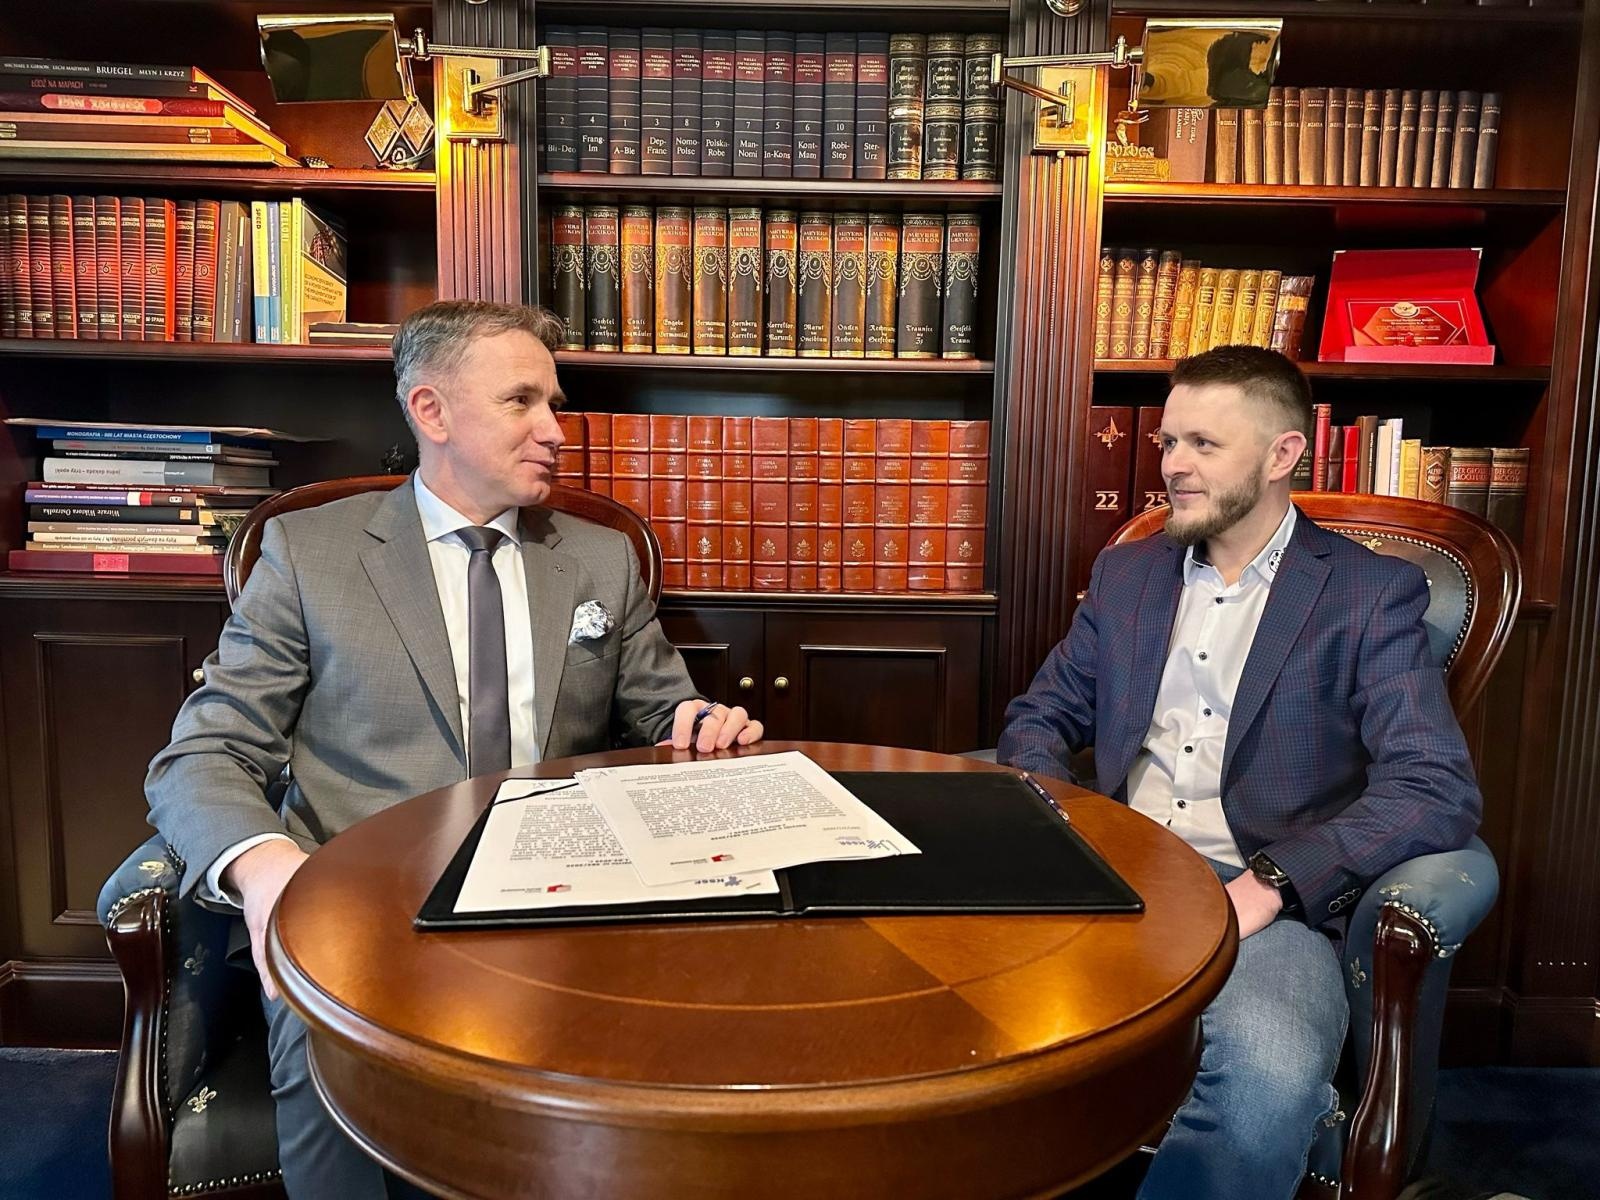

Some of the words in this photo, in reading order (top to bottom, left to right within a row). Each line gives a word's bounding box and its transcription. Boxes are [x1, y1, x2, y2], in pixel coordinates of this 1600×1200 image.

[96, 66, 133, 76] BRUEGEL
[58, 81, 84, 89] MAPACH
[560, 116, 565, 124] 2
[590, 116, 595, 124] 4
[654, 119, 660, 127] 3
[715, 120, 720, 129] 9
[746, 121, 751, 129] 7
[775, 121, 780, 130] 5
[805, 123, 810, 132] 6
[836, 123, 844, 131] 10
[588, 144, 598, 152] Im
[647, 146, 667, 155] Franc
[708, 148, 725, 157] Robe
[1106, 141, 1155, 158] Forbes
[738, 149, 758, 158] Nomi
[798, 151, 817, 160] Mam
[831, 152, 847, 160] Step
[864, 151, 878, 160] Urz
[16, 260, 23, 272] 2
[34, 262, 44, 272] 3
[80, 261, 88, 274] 5
[102, 261, 111, 274] 6
[126, 262, 133, 274] 7
[150, 263, 158, 275] 8
[196, 264, 208, 276] 10
[180, 266, 186, 276] 9
[1095, 494, 1118, 508] 22
[1144, 494, 1166, 508] 25
[72, 508, 96, 517] Wiktora
[97, 508, 120, 517] Witraże
